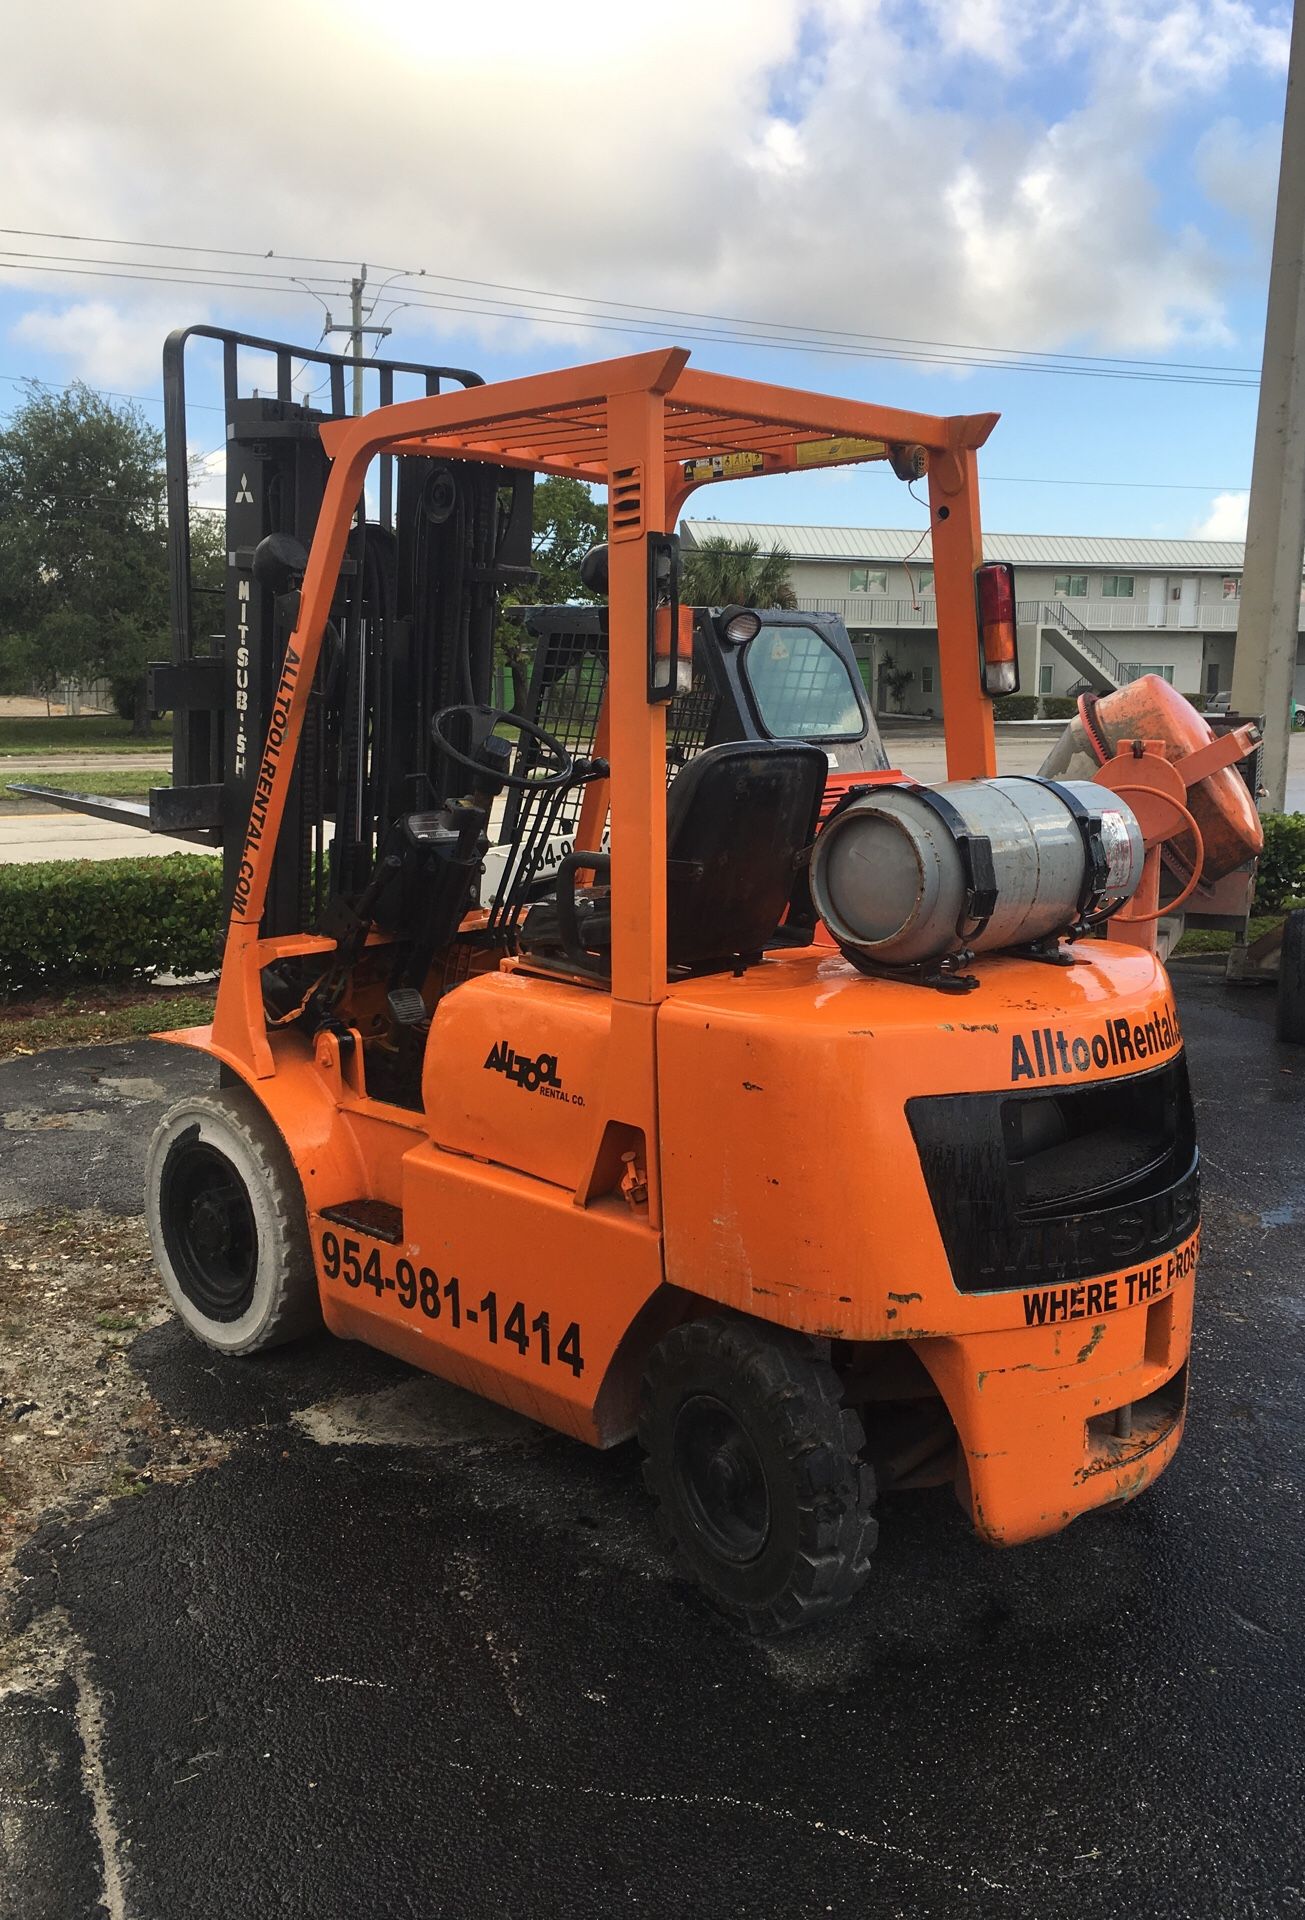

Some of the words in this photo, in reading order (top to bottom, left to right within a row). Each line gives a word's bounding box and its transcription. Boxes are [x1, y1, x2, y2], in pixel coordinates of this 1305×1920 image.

[231, 645, 301, 916] ALLTOOLRENTAL.COM
[540, 1086, 570, 1102] RENTAL
[571, 1095, 586, 1107] CO.
[321, 1231, 585, 1378] 954-981-1414
[1023, 1279, 1118, 1326] WHERE
[1125, 1264, 1162, 1305] THE
